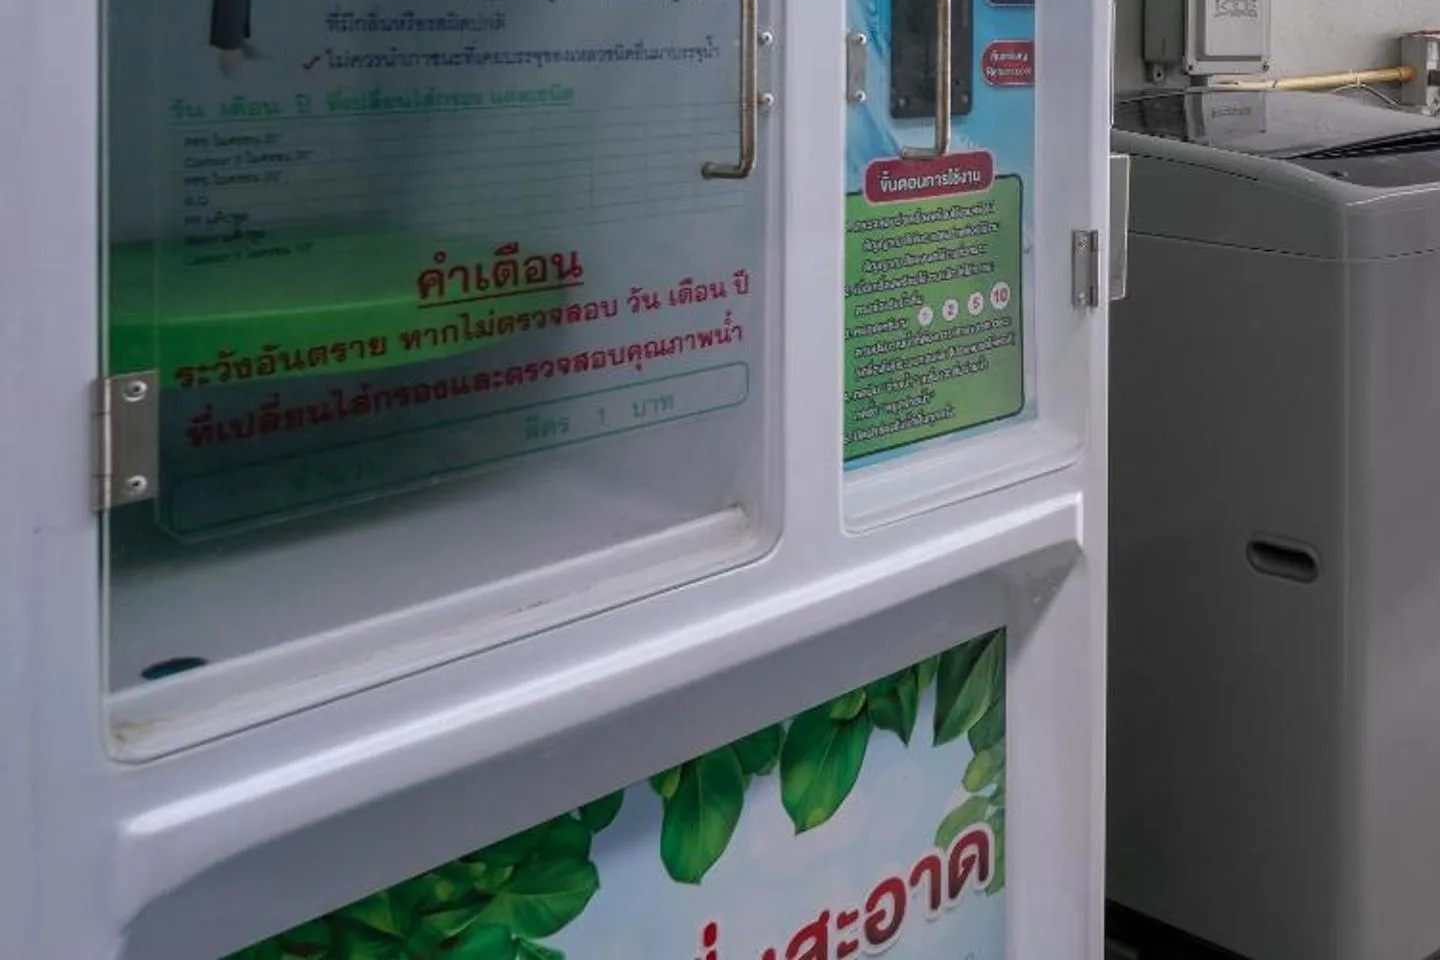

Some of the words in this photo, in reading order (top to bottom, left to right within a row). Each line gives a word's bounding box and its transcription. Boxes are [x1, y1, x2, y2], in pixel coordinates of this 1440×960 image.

[416, 241, 584, 302] คำเตือน
[174, 334, 388, 389] ระวังอันตราย
[626, 285, 662, 316] วัน
[668, 276, 728, 307] เดือน
[733, 267, 752, 296] ปี
